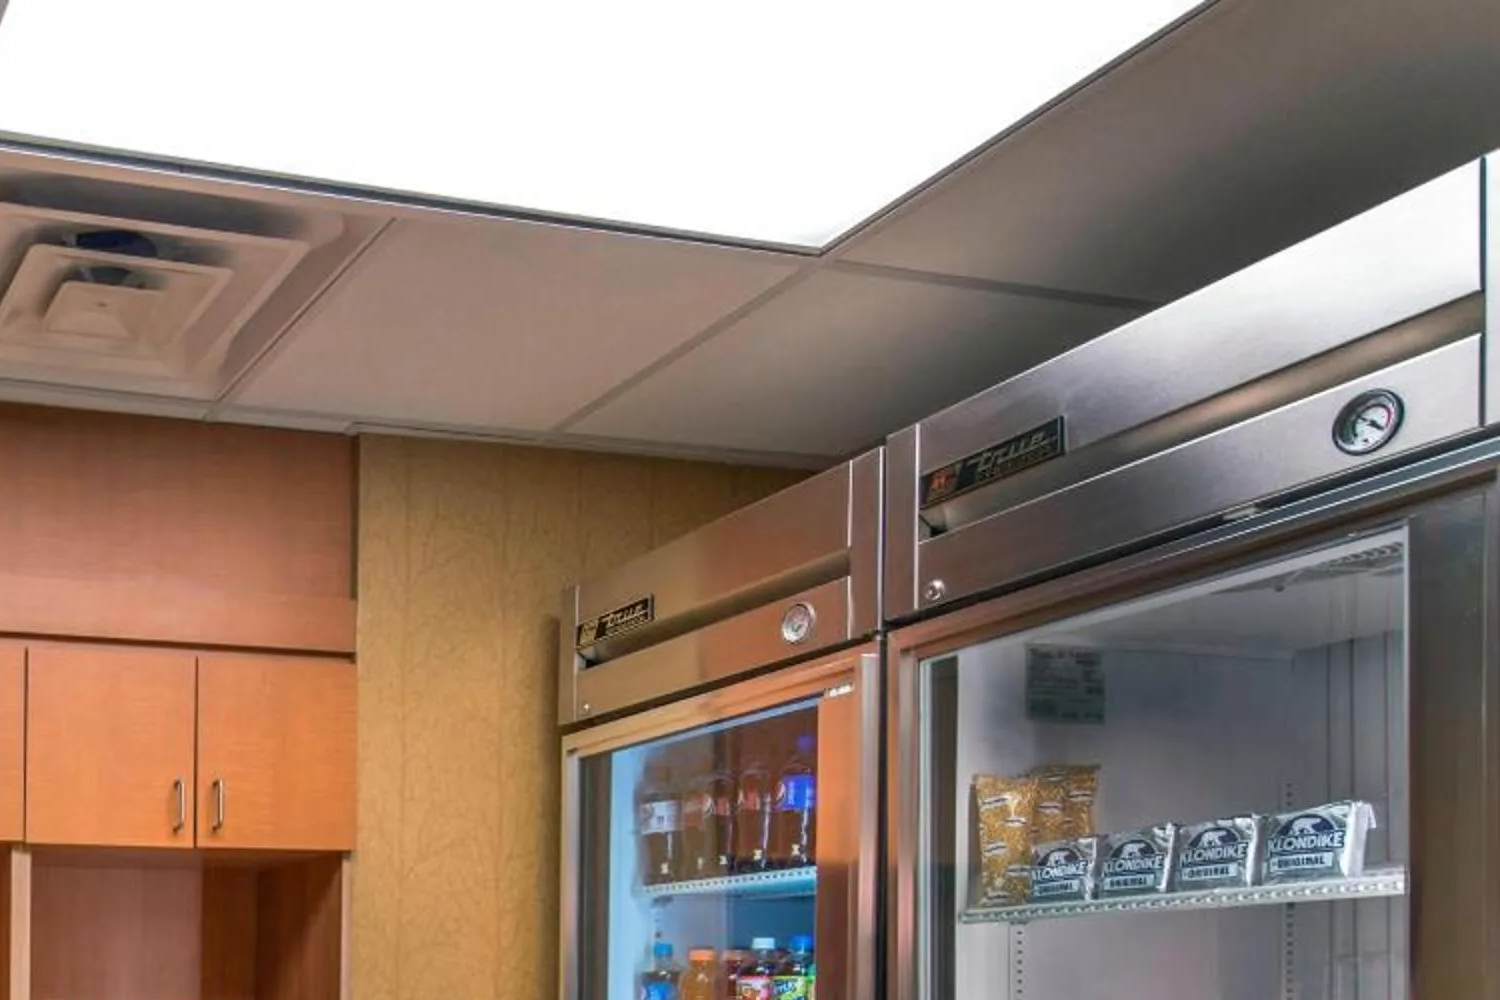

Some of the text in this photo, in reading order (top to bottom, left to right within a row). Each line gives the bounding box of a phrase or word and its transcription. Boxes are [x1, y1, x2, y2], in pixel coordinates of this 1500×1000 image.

[1180, 842, 1247, 866] KLONDIKE
[1268, 830, 1345, 856] KLONDIKE
[1102, 855, 1163, 877] KLONDIKE
